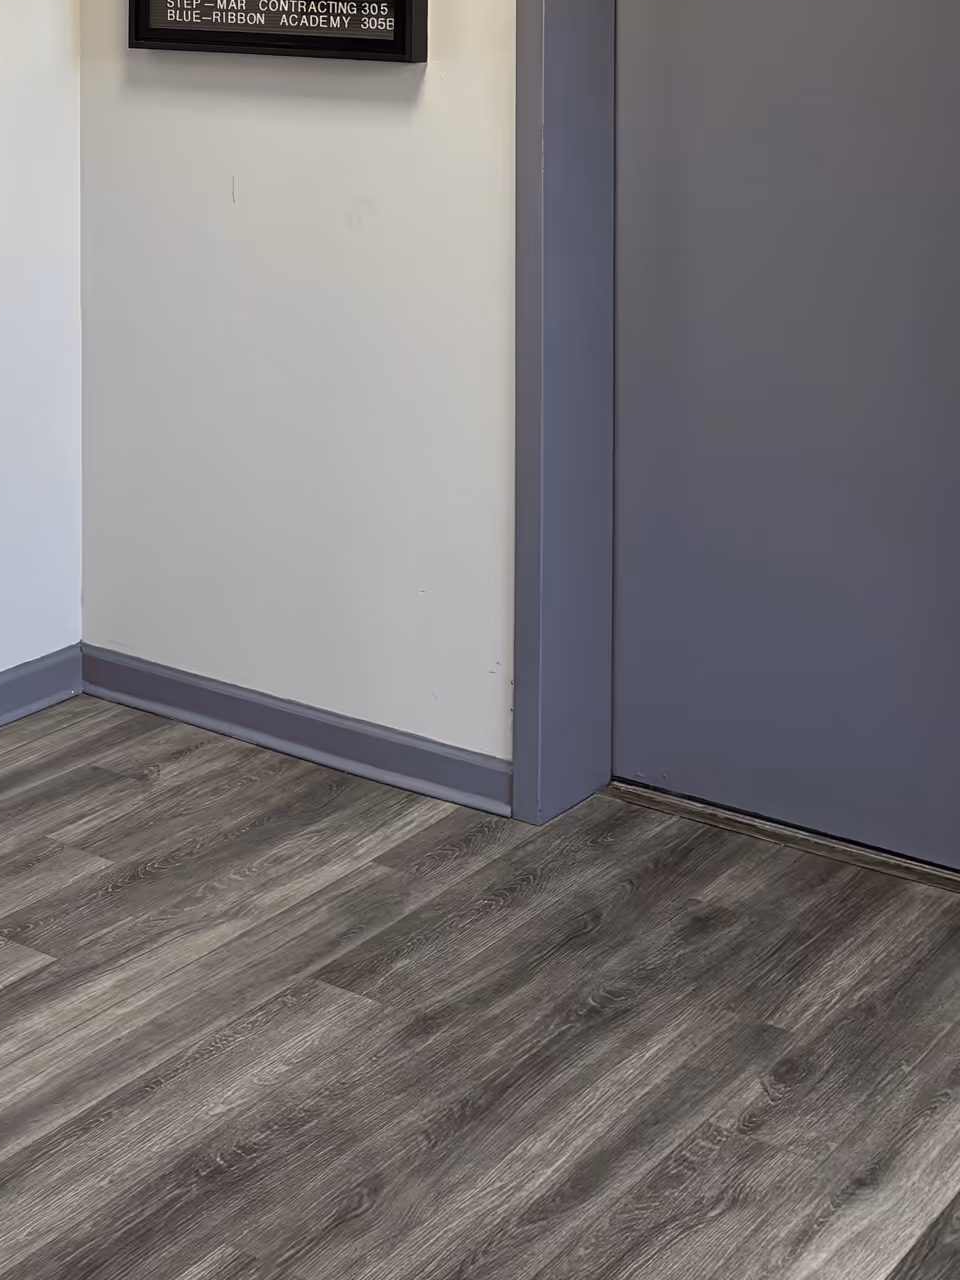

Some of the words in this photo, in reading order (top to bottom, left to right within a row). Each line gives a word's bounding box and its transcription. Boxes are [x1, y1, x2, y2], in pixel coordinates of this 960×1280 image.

[259, 0, 357, 14] CONTRACTING
[361, 3, 388, 15] 305
[280, 15, 350, 28] ACADEMY
[361, 18, 394, 30] 305B
